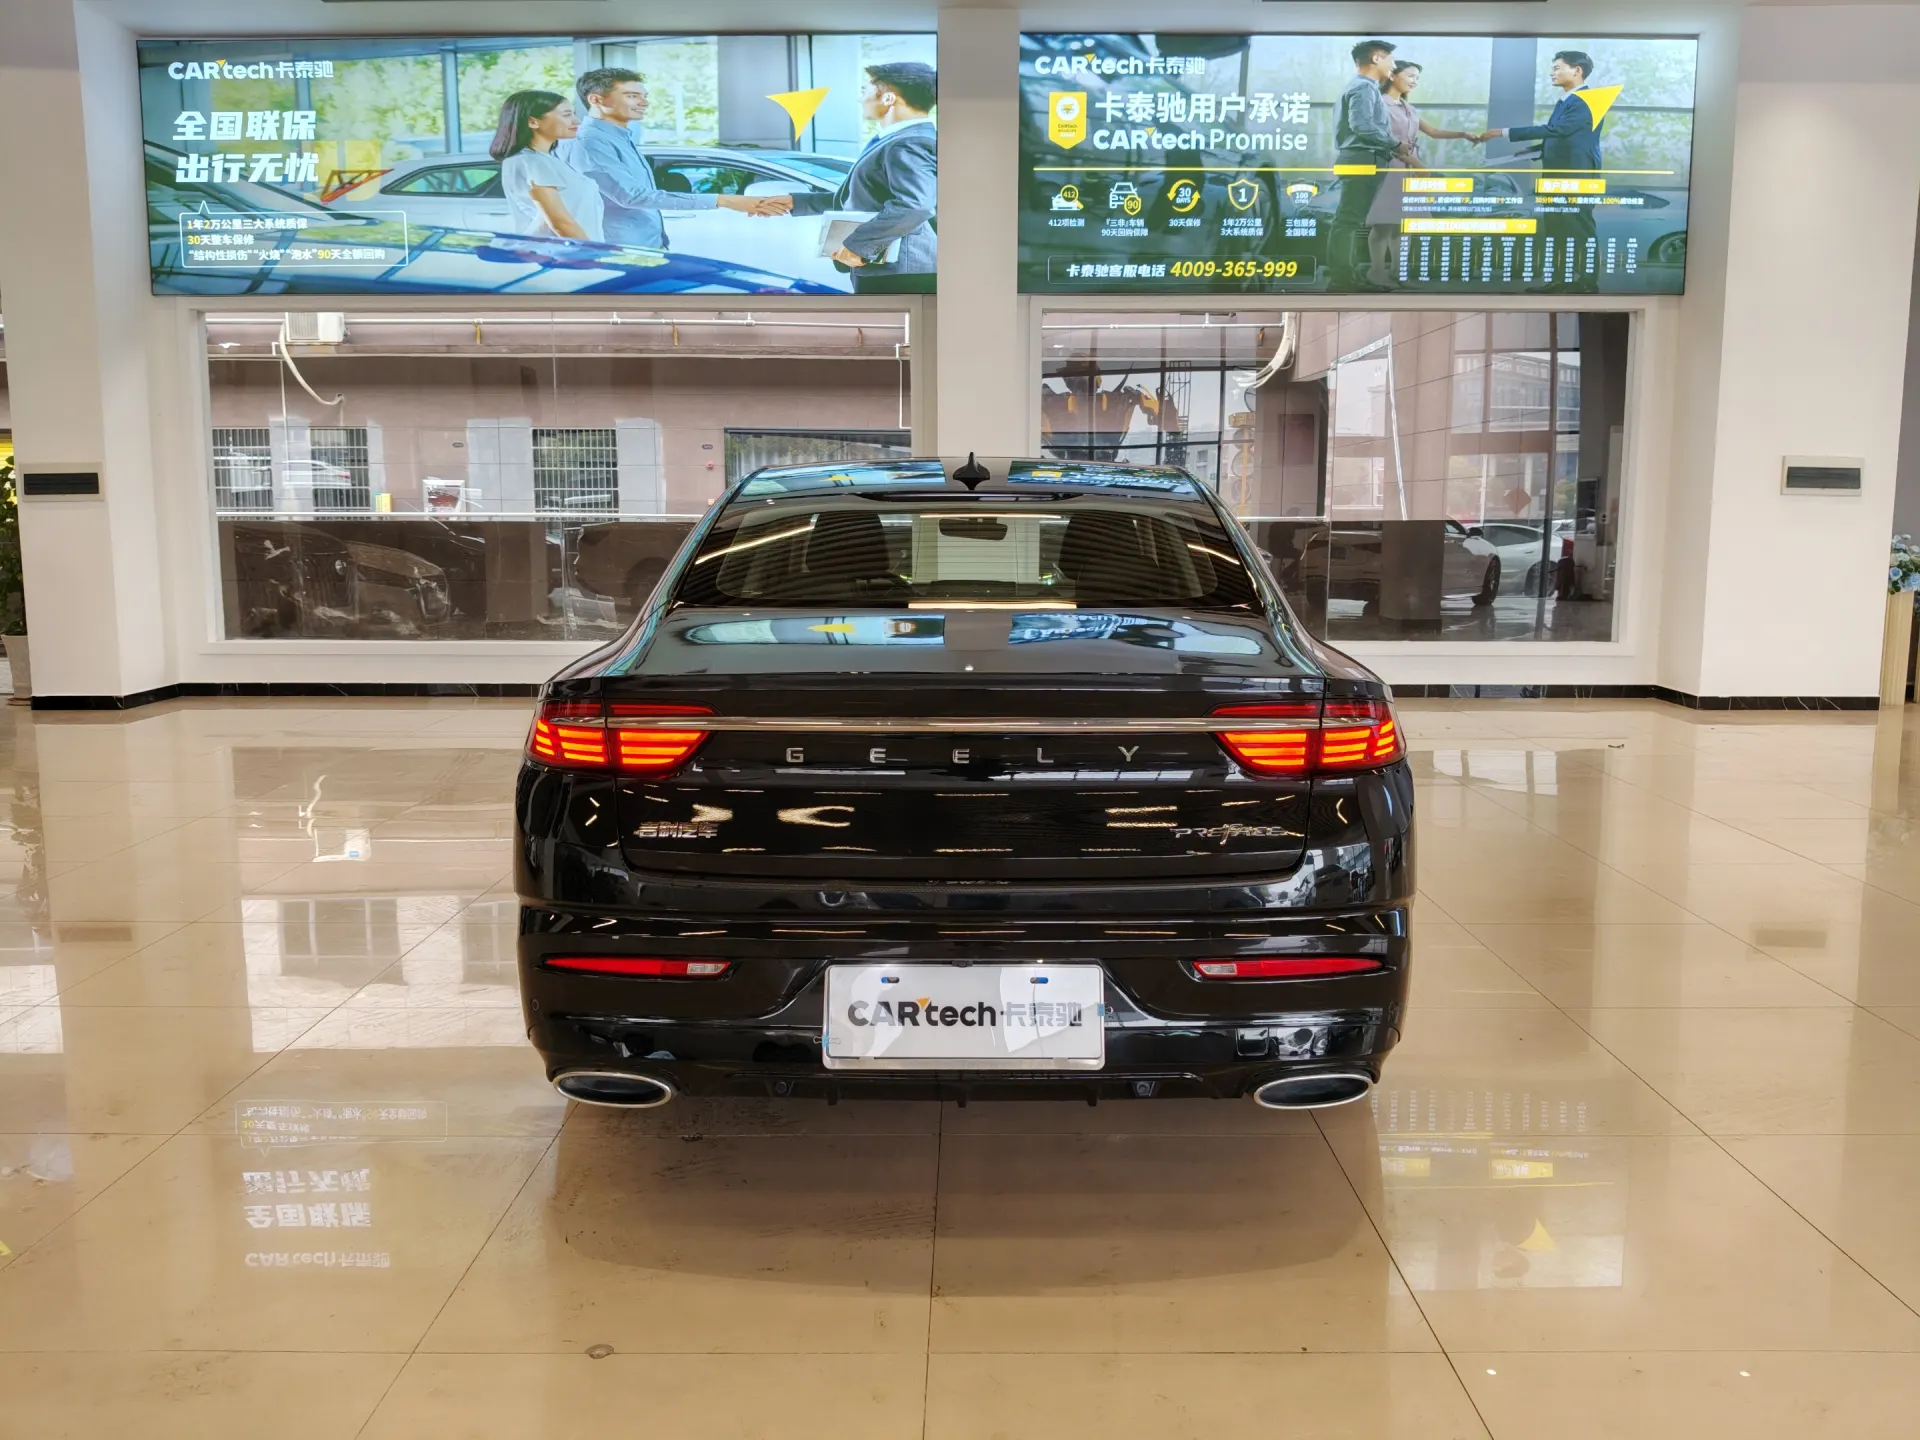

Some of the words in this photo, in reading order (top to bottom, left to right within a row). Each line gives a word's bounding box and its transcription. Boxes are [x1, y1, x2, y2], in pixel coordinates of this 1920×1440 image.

[168, 60, 274, 80] CARtech
[275, 60, 334, 79] 卡泰驰
[1034, 54, 1143, 75] CARtech
[1095, 91, 1311, 124] 卡泰驰用户承诺
[172, 110, 317, 141] 全国联保
[1093, 127, 1205, 151] CARtech
[1210, 128, 1308, 151] Promise
[175, 153, 320, 183] 出行无忧
[1062, 190, 1076, 198] 412
[1178, 187, 1191, 197] 30
[1238, 188, 1248, 202] 1
[1127, 200, 1139, 209] 90
[187, 218, 308, 230] 1年2万公里三大系统质保
[1048, 218, 1085, 227] 412项检测
[1168, 218, 1201, 227] 30天保修
[1222, 218, 1262, 227] 1年2万公里
[187, 234, 254, 246] 30天整车保修
[1066, 264, 1166, 278] 卡泰驰客服电话
[1170, 260, 1297, 278] 4009-365-999
